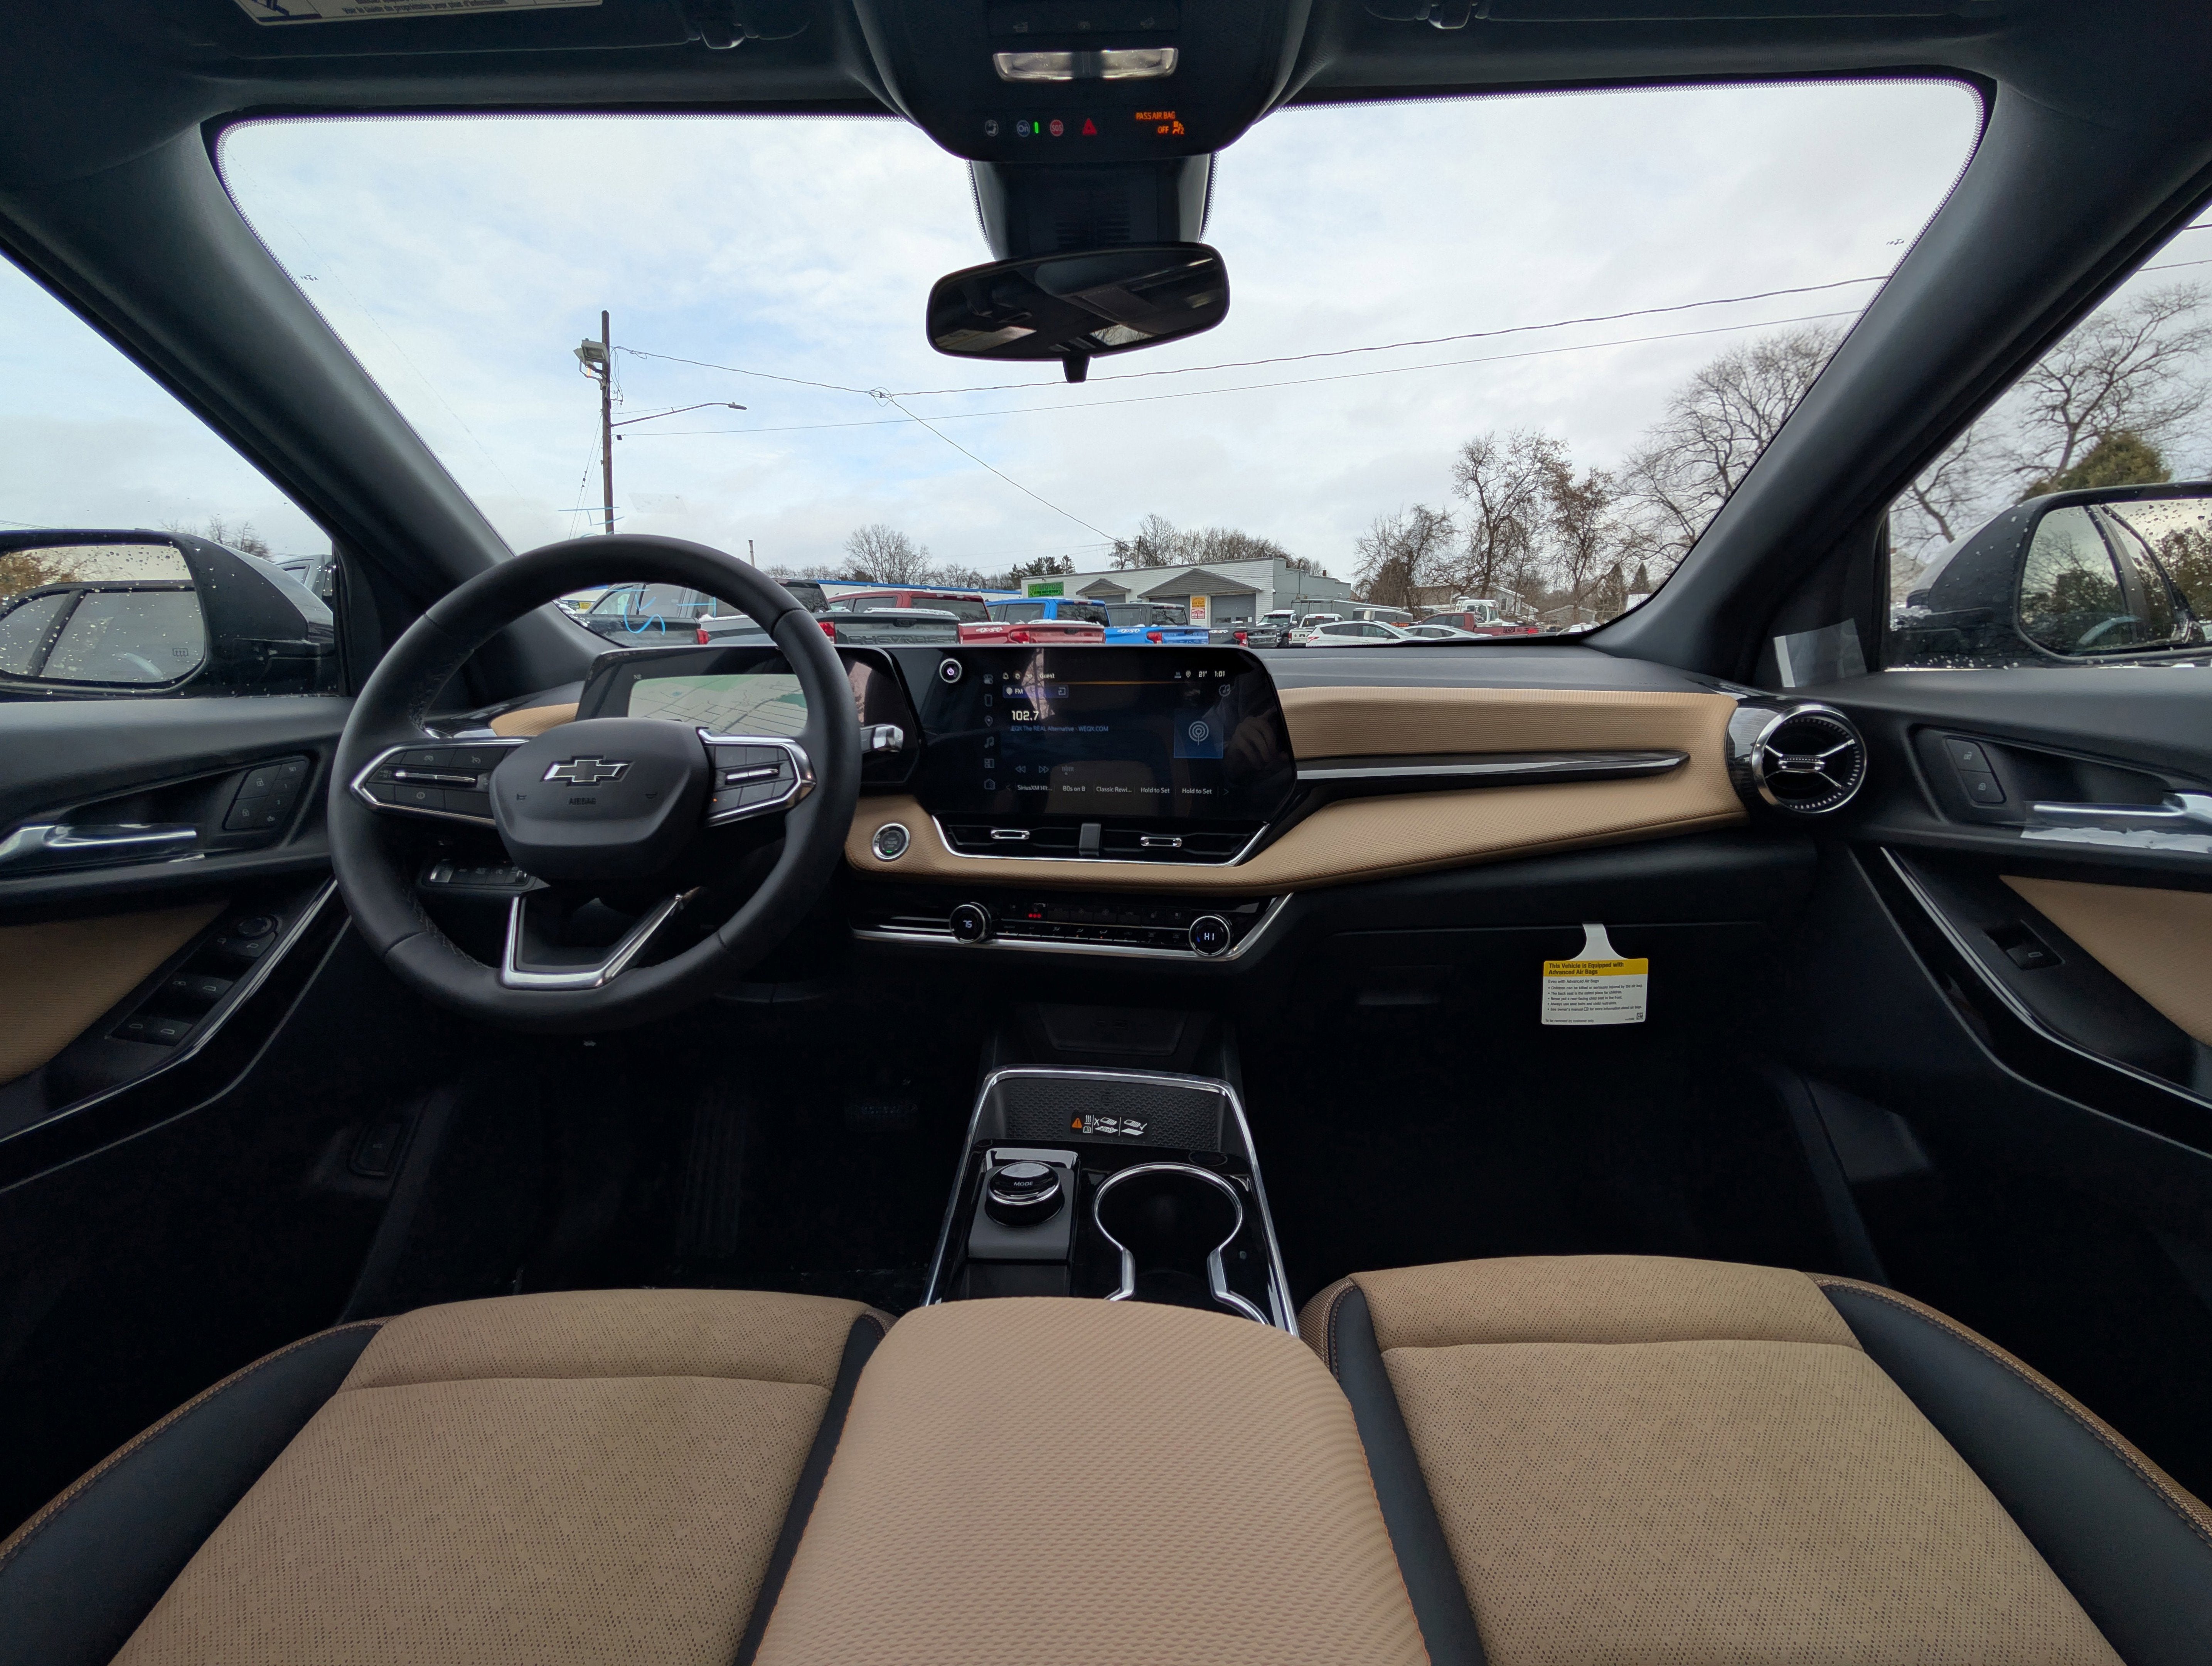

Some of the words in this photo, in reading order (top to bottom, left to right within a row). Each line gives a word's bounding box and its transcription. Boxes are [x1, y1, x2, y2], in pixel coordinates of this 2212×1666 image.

[1158, 126, 1169, 134] OFF
[1011, 710, 1039, 721] 102.7
[569, 797, 596, 805] AIRBAG
[1204, 932, 1214, 941] HI
